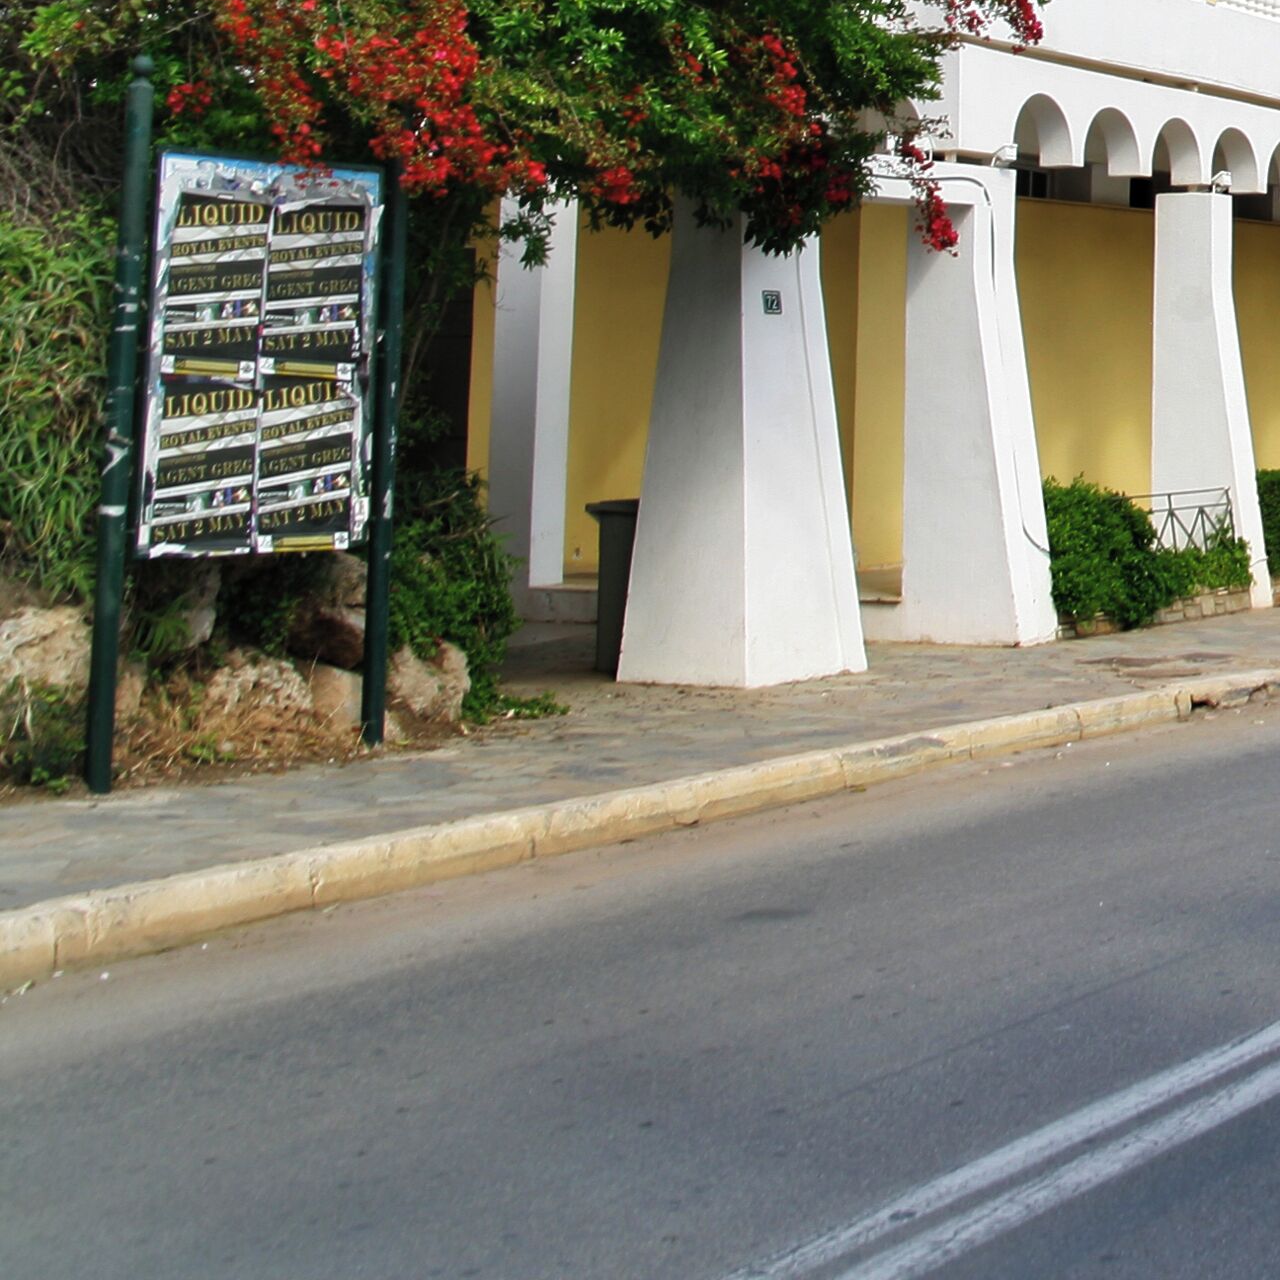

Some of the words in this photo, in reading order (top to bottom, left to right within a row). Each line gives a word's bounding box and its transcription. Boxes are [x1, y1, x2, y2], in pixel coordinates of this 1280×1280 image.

[178, 203, 264, 225] LIQUID
[277, 212, 359, 234] LIQUID
[172, 241, 215, 256] ROYAL
[218, 236, 265, 251] EVENTS
[271, 248, 312, 263] ROYAL
[316, 243, 361, 258] EVENTS
[170, 275, 217, 291] AGENT
[220, 273, 261, 288] GREG
[269, 281, 314, 297] AGENT
[320, 279, 358, 293] GREG
[766, 295, 778, 309] 72
[165, 331, 199, 348] SAT
[203, 329, 212, 345] 2
[217, 326, 255, 345] MAY
[265, 335, 296, 350] SAT
[302, 334, 311, 348] 2
[316, 330, 351, 347] MAY
[166, 390, 253, 417] LIQUID
[161, 431, 205, 448] ROYAL
[207, 421, 255, 439] EVENTS
[263, 421, 304, 440] ROYAL
[307, 410, 352, 429] EVENTS
[159, 465, 208, 484] AGENT
[212, 458, 252, 475] GREG
[262, 454, 307, 474] AGENT
[312, 447, 350, 464] GREG
[261, 509, 292, 528] SAT
[297, 506, 305, 522] 2
[310, 498, 345, 520] MAY
[153, 521, 189, 541] SAT
[194, 519, 204, 536] 2
[209, 512, 247, 533] MAY
